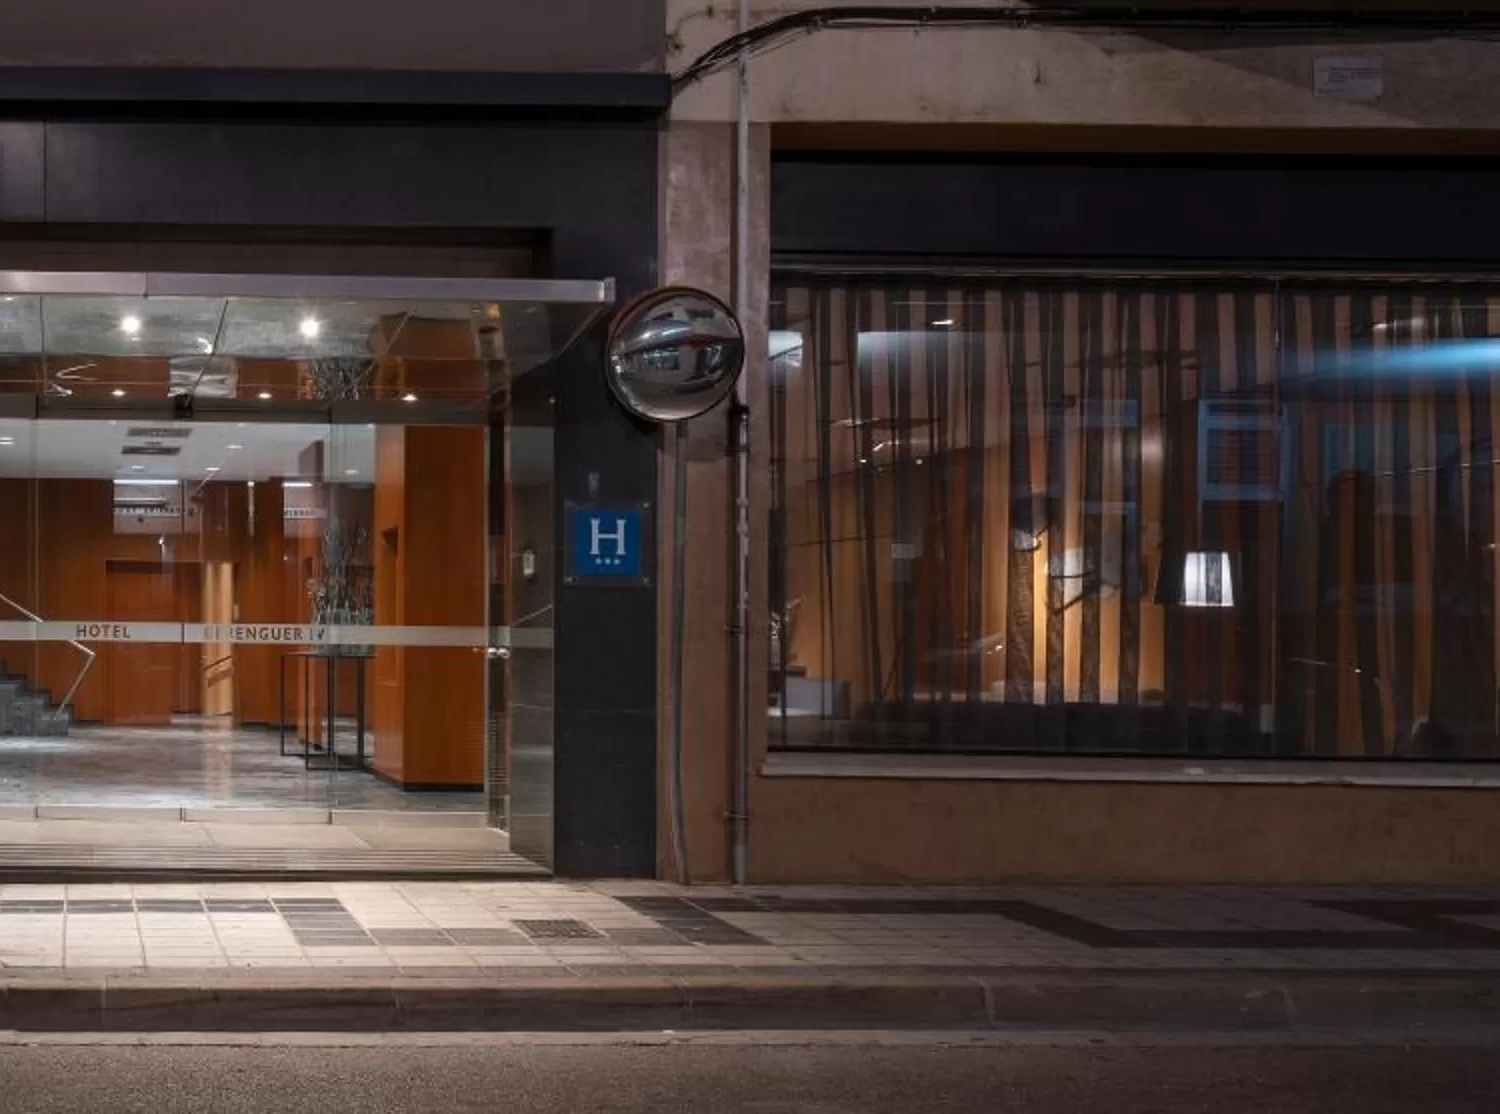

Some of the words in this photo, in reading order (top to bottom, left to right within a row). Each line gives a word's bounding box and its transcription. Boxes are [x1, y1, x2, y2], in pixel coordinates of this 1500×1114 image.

[590, 519, 626, 555] H
[75, 624, 132, 638] HOTEL
[204, 626, 304, 641] ENGUER
